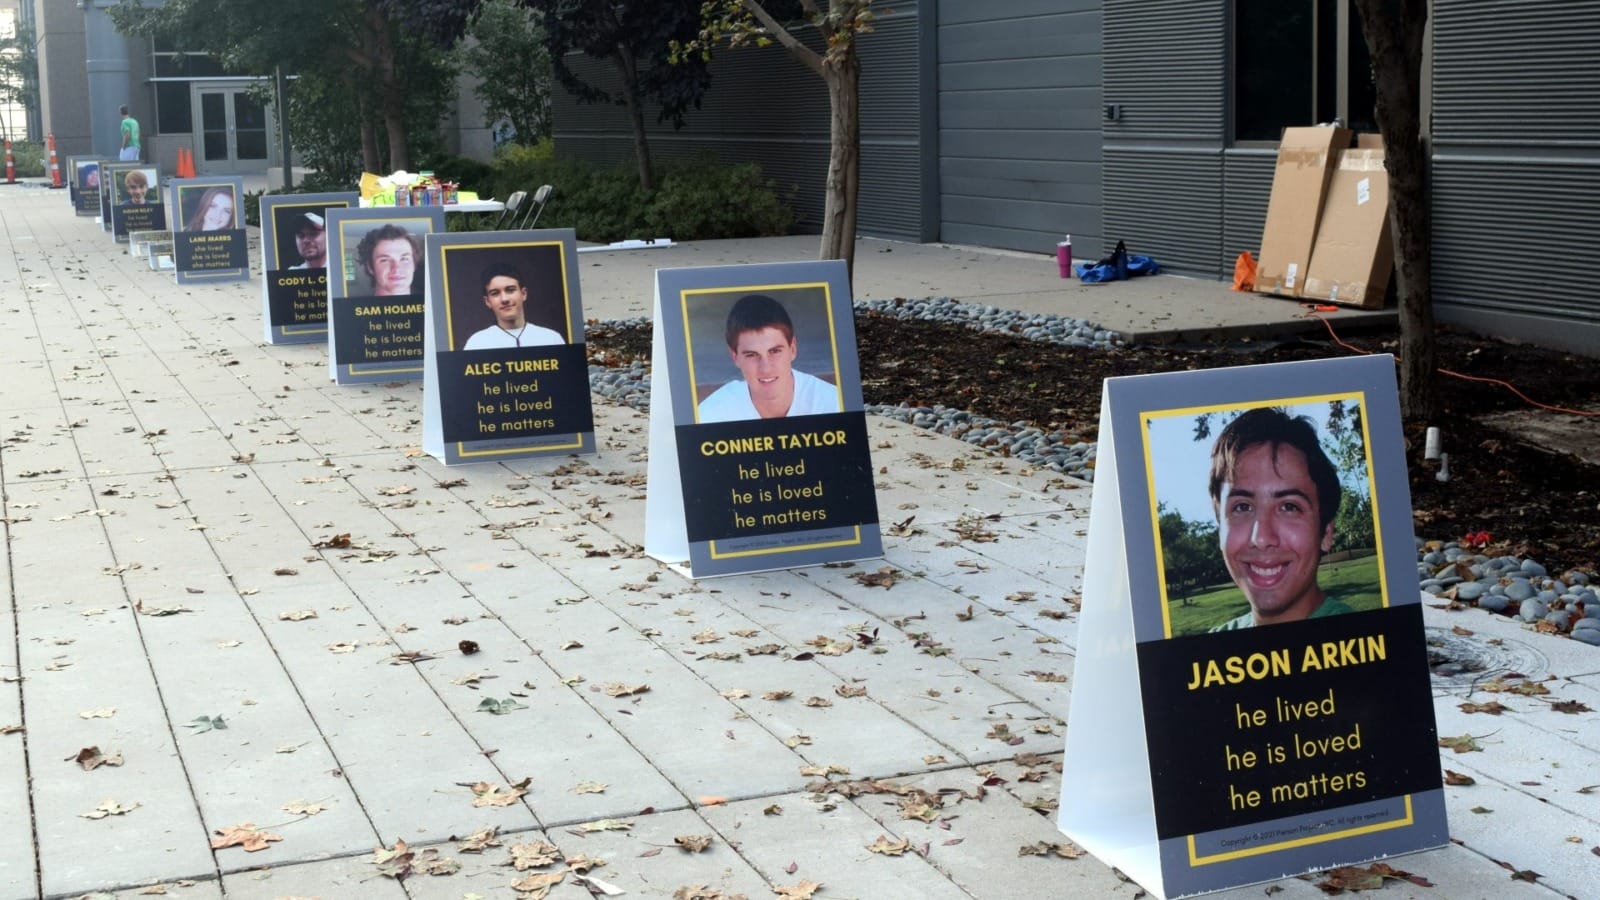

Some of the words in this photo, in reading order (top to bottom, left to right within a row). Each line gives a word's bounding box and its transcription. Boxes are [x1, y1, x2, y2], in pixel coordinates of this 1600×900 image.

[278, 276, 305, 286] CODY
[308, 276, 316, 284] L.
[298, 289, 309, 298] he
[311, 289, 327, 297] live
[294, 301, 305, 309] he
[317, 299, 328, 308] lo
[355, 306, 381, 316] SAM
[295, 312, 306, 320] he
[309, 312, 328, 320] mat
[369, 320, 382, 331] he
[386, 319, 411, 330] lived
[364, 335, 377, 345] he
[381, 335, 390, 344] is
[392, 333, 421, 343] loved
[365, 348, 378, 358] he
[382, 348, 423, 357] matters
[464, 362, 502, 376] ALEC
[505, 359, 559, 373] TURNER
[483, 382, 501, 395] he
[505, 379, 538, 394] lived
[477, 401, 495, 414] he
[500, 402, 511, 413] is
[515, 396, 552, 411] loved
[479, 420, 496, 433] he
[502, 417, 555, 431] matters
[700, 436, 774, 456] CONNER
[778, 430, 847, 450] TAYLOR
[738, 464, 760, 480] he
[765, 458, 806, 478] lived
[732, 488, 752, 504] he
[759, 489, 772, 502] is
[777, 480, 823, 500] loved
[735, 512, 756, 528] he
[762, 508, 827, 525] matters
[1187, 649, 1291, 690] JASON
[1301, 634, 1387, 672] ARKIN
[1236, 703, 1267, 729] he
[1276, 688, 1335, 722] lived
[1225, 745, 1257, 771] he
[1266, 743, 1286, 764] is
[1295, 723, 1361, 759] loved
[1230, 785, 1261, 811] he
[1272, 770, 1367, 803] matters
